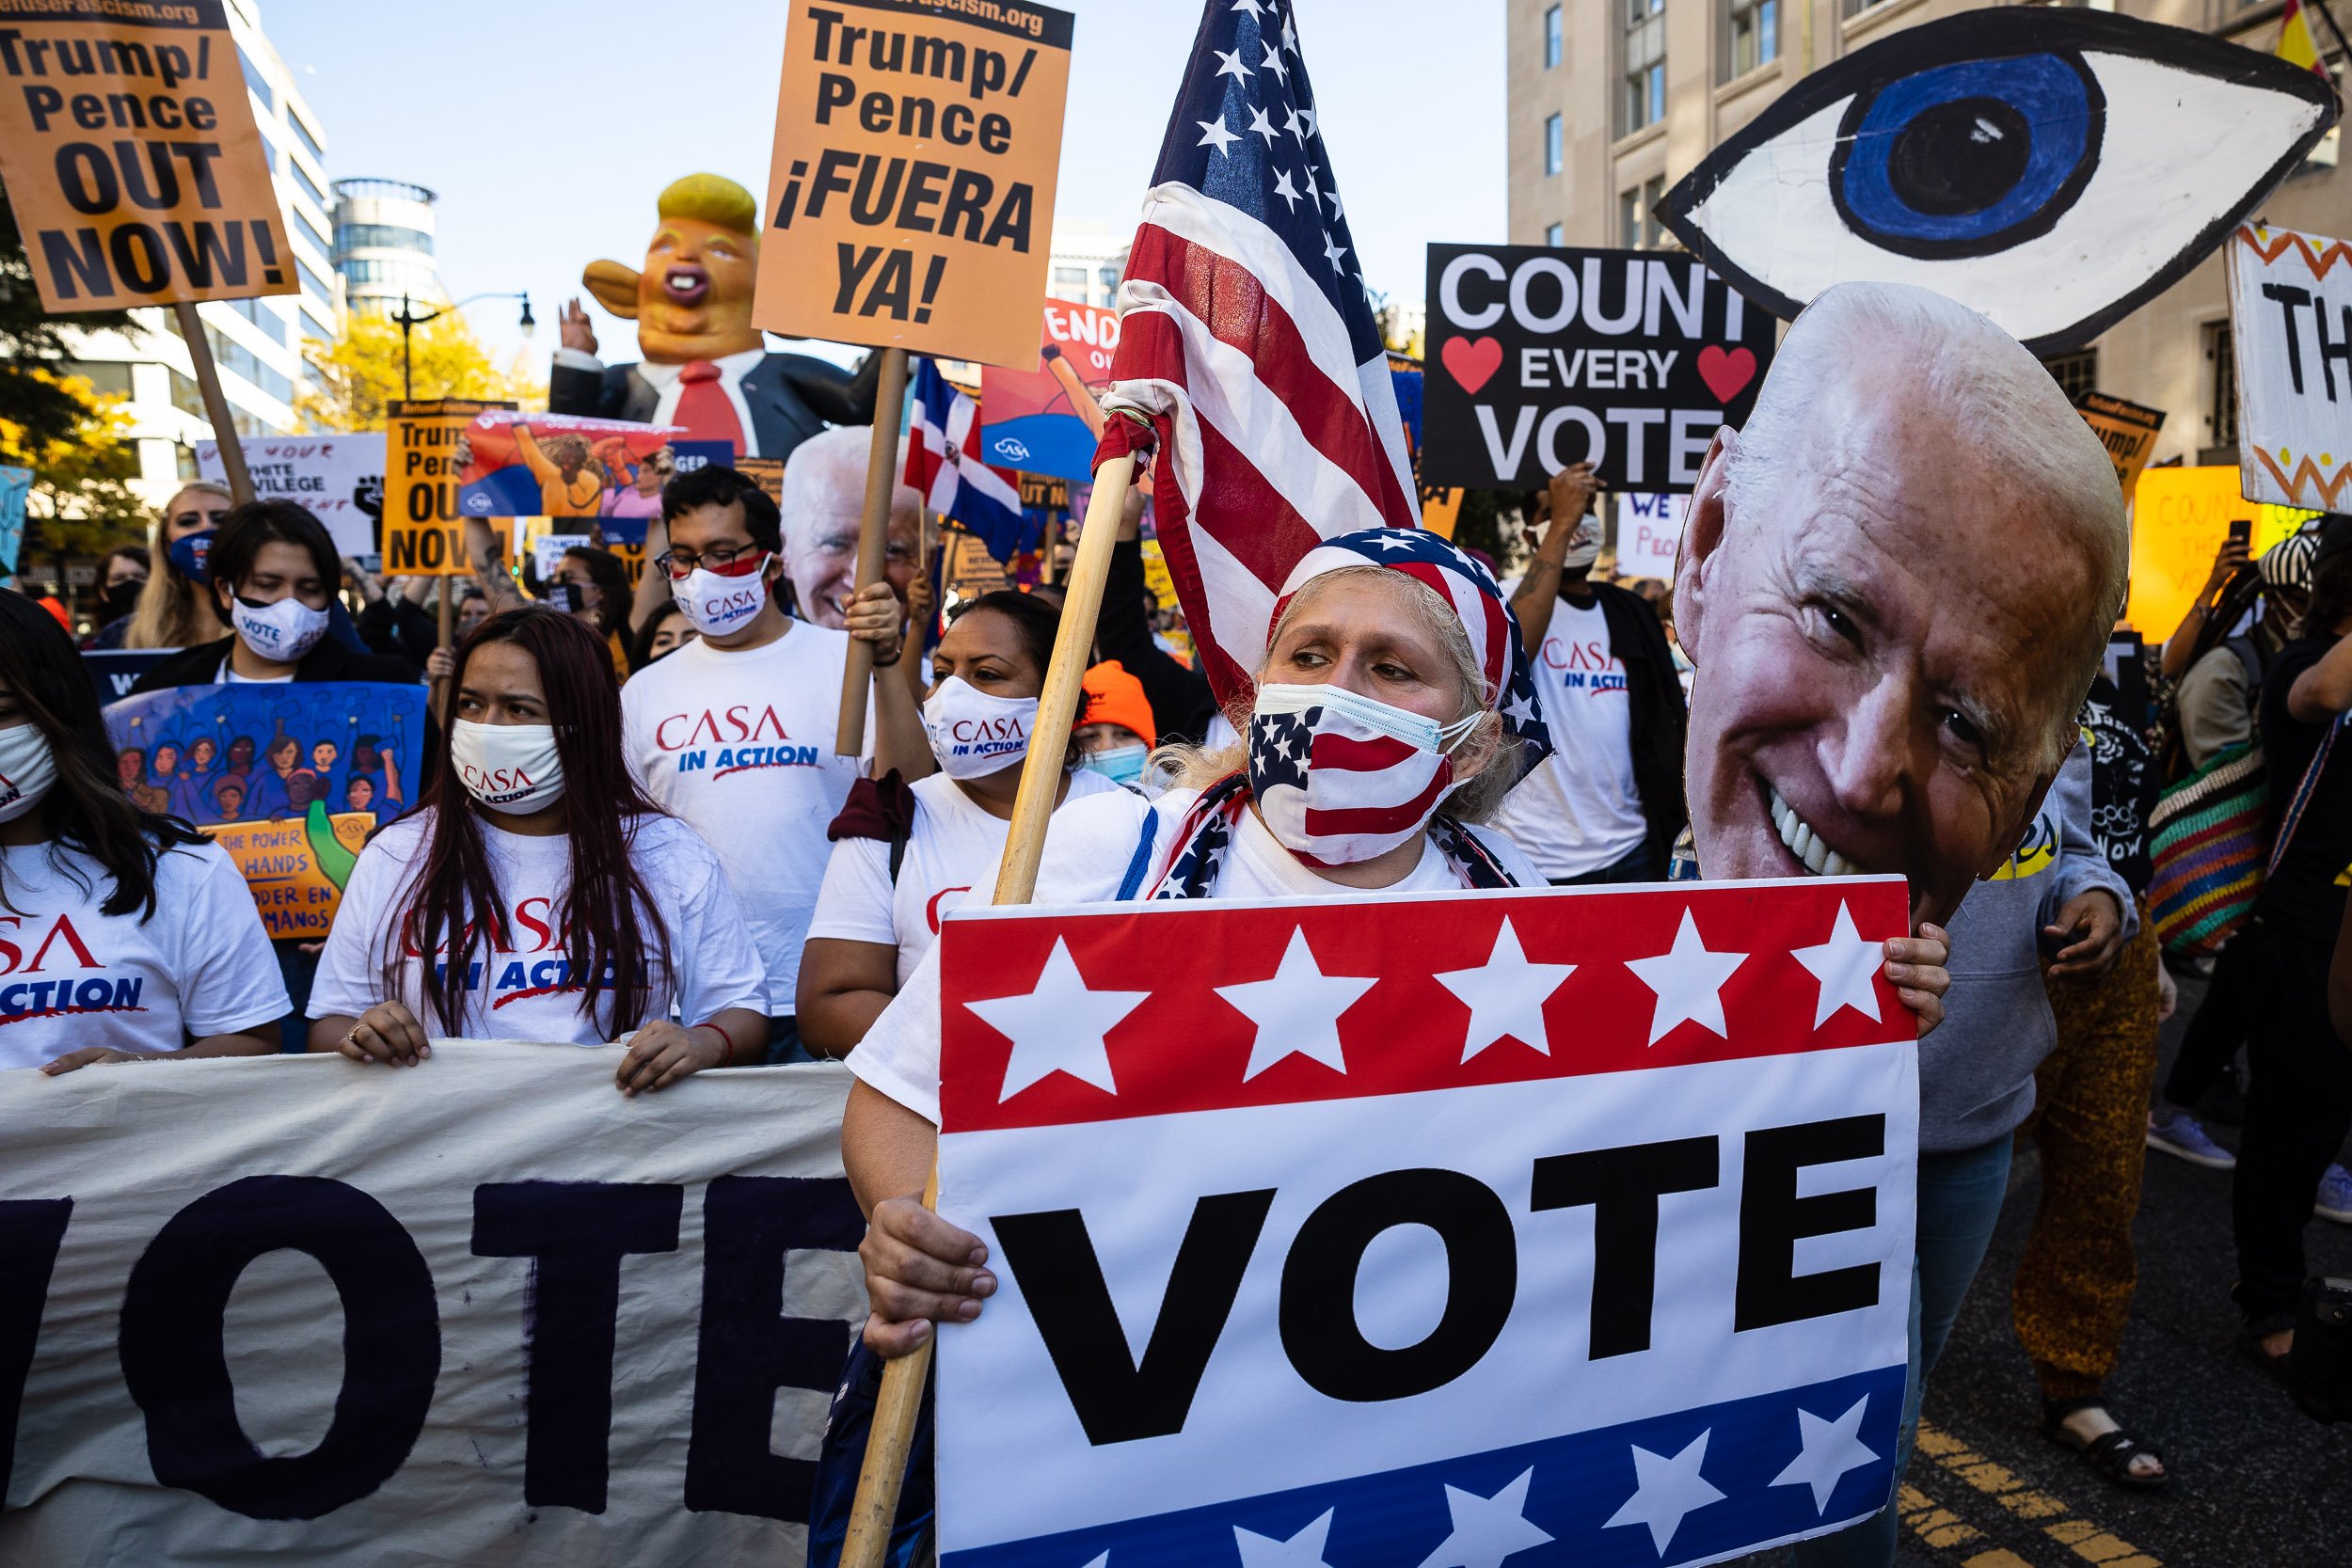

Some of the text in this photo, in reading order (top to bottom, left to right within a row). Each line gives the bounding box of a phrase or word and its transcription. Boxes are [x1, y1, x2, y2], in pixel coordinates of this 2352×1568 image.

[0, 29, 210, 88] Trump/
[808, 8, 1038, 100] Trump/
[22, 85, 217, 132] Pence
[816, 72, 1011, 154] Pence
[55, 140, 221, 214] OUT
[773, 149, 1034, 254] ¡FUERA
[39, 219, 282, 299] NOW!
[833, 242, 947, 325] YA!
[1520, 348, 1679, 389] EVERY
[1474, 404, 1724, 483] VOTE
[706, 589, 756, 617] CASA
[242, 616, 281, 641] VOTE
[1565, 673, 1628, 689] IN ACTI
[658, 705, 791, 751] CASA
[952, 718, 1025, 742] CASA
[952, 746, 969, 755] IN
[973, 740, 1025, 753] ACTION
[464, 765, 535, 792] CASA
[678, 746, 818, 772] IN ACTION
[485, 787, 536, 804] ACTION
[252, 829, 303, 848] POWER
[245, 854, 310, 875] HANDS
[253, 887, 332, 907] ODER EN
[400, 896, 602, 958] CAS
[989, 1113, 1885, 1447] VOTE
